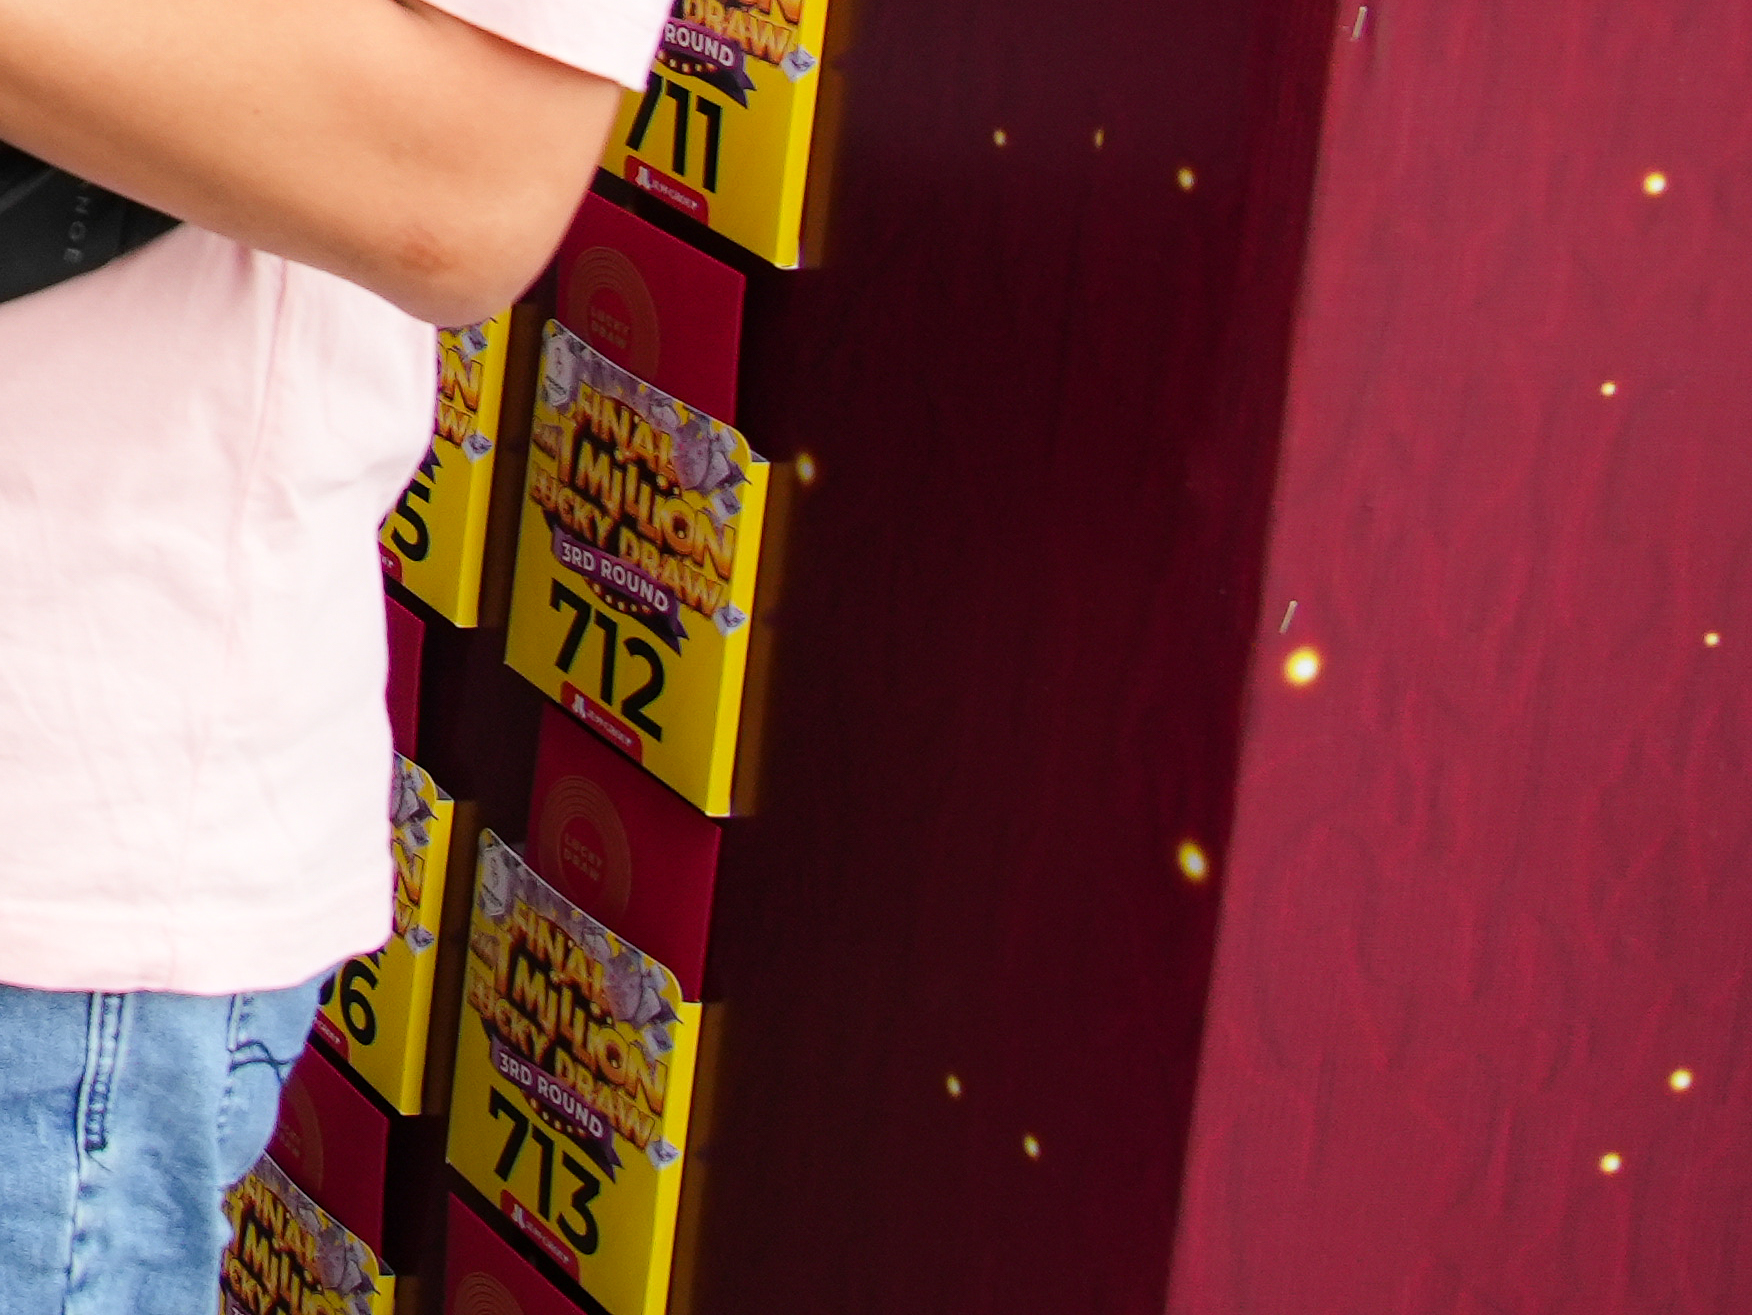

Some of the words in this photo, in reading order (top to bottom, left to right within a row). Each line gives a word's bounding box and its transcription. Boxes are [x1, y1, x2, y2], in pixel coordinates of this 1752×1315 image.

[665, 23, 734, 67] ROUND
[626, 71, 722, 194] 711
[561, 542, 594, 571] 3RD
[601, 558, 668, 612] ROUND
[550, 578, 664, 742] 712
[499, 1053, 531, 1085] 3RD
[537, 1080, 603, 1137] ROUND
[489, 1085, 600, 1255] 713
